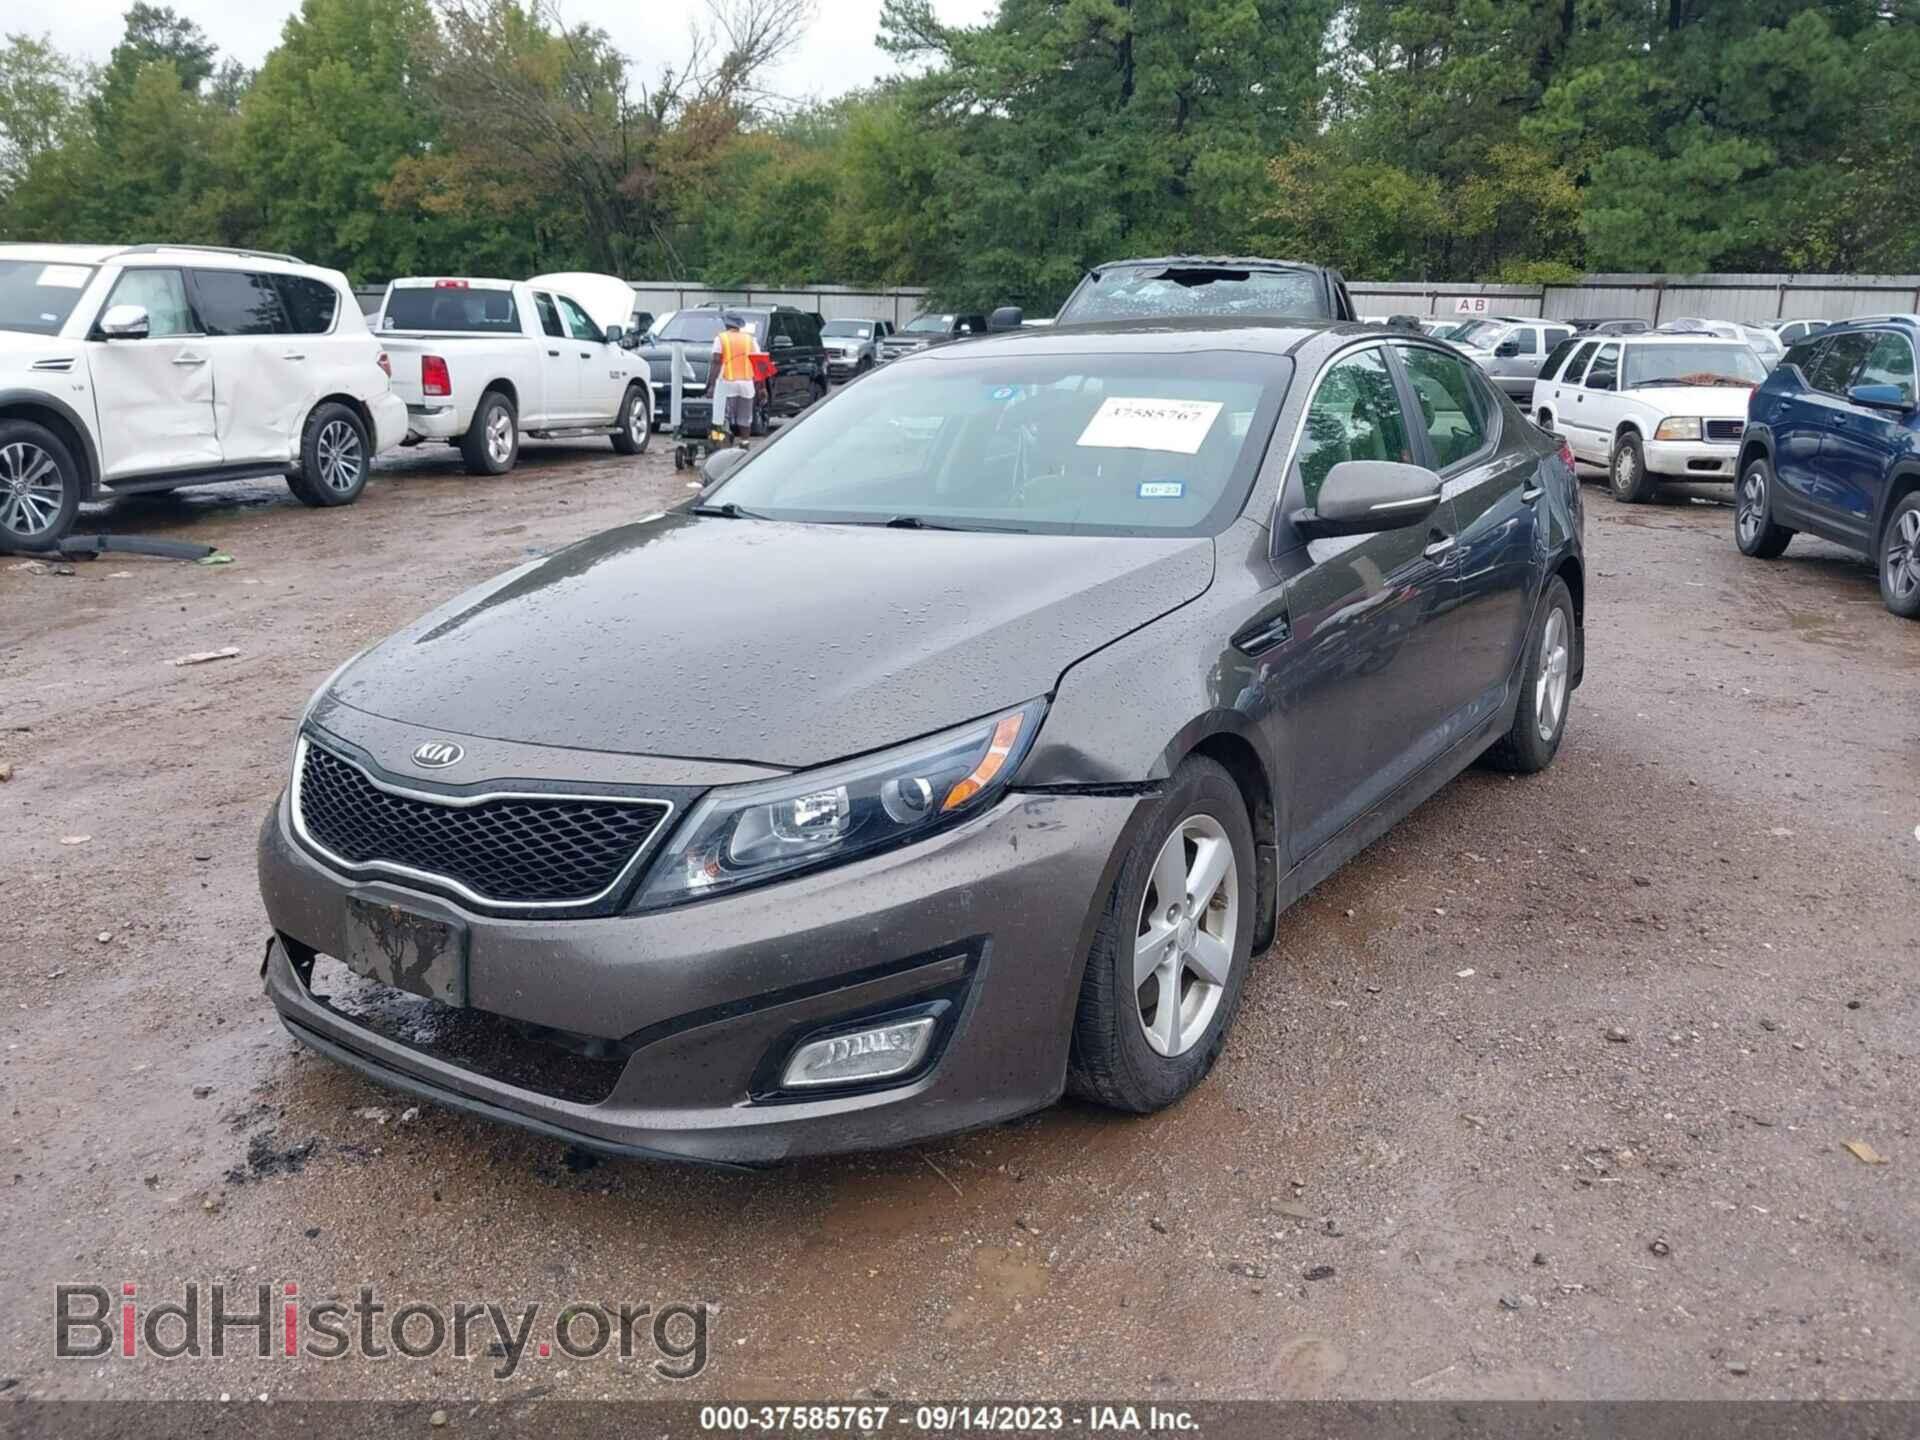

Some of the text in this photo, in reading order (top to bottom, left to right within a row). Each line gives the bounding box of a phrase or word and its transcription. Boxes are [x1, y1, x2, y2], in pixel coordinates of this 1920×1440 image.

[1460, 299, 1485, 311] A B
[415, 743, 455, 762] KIA
